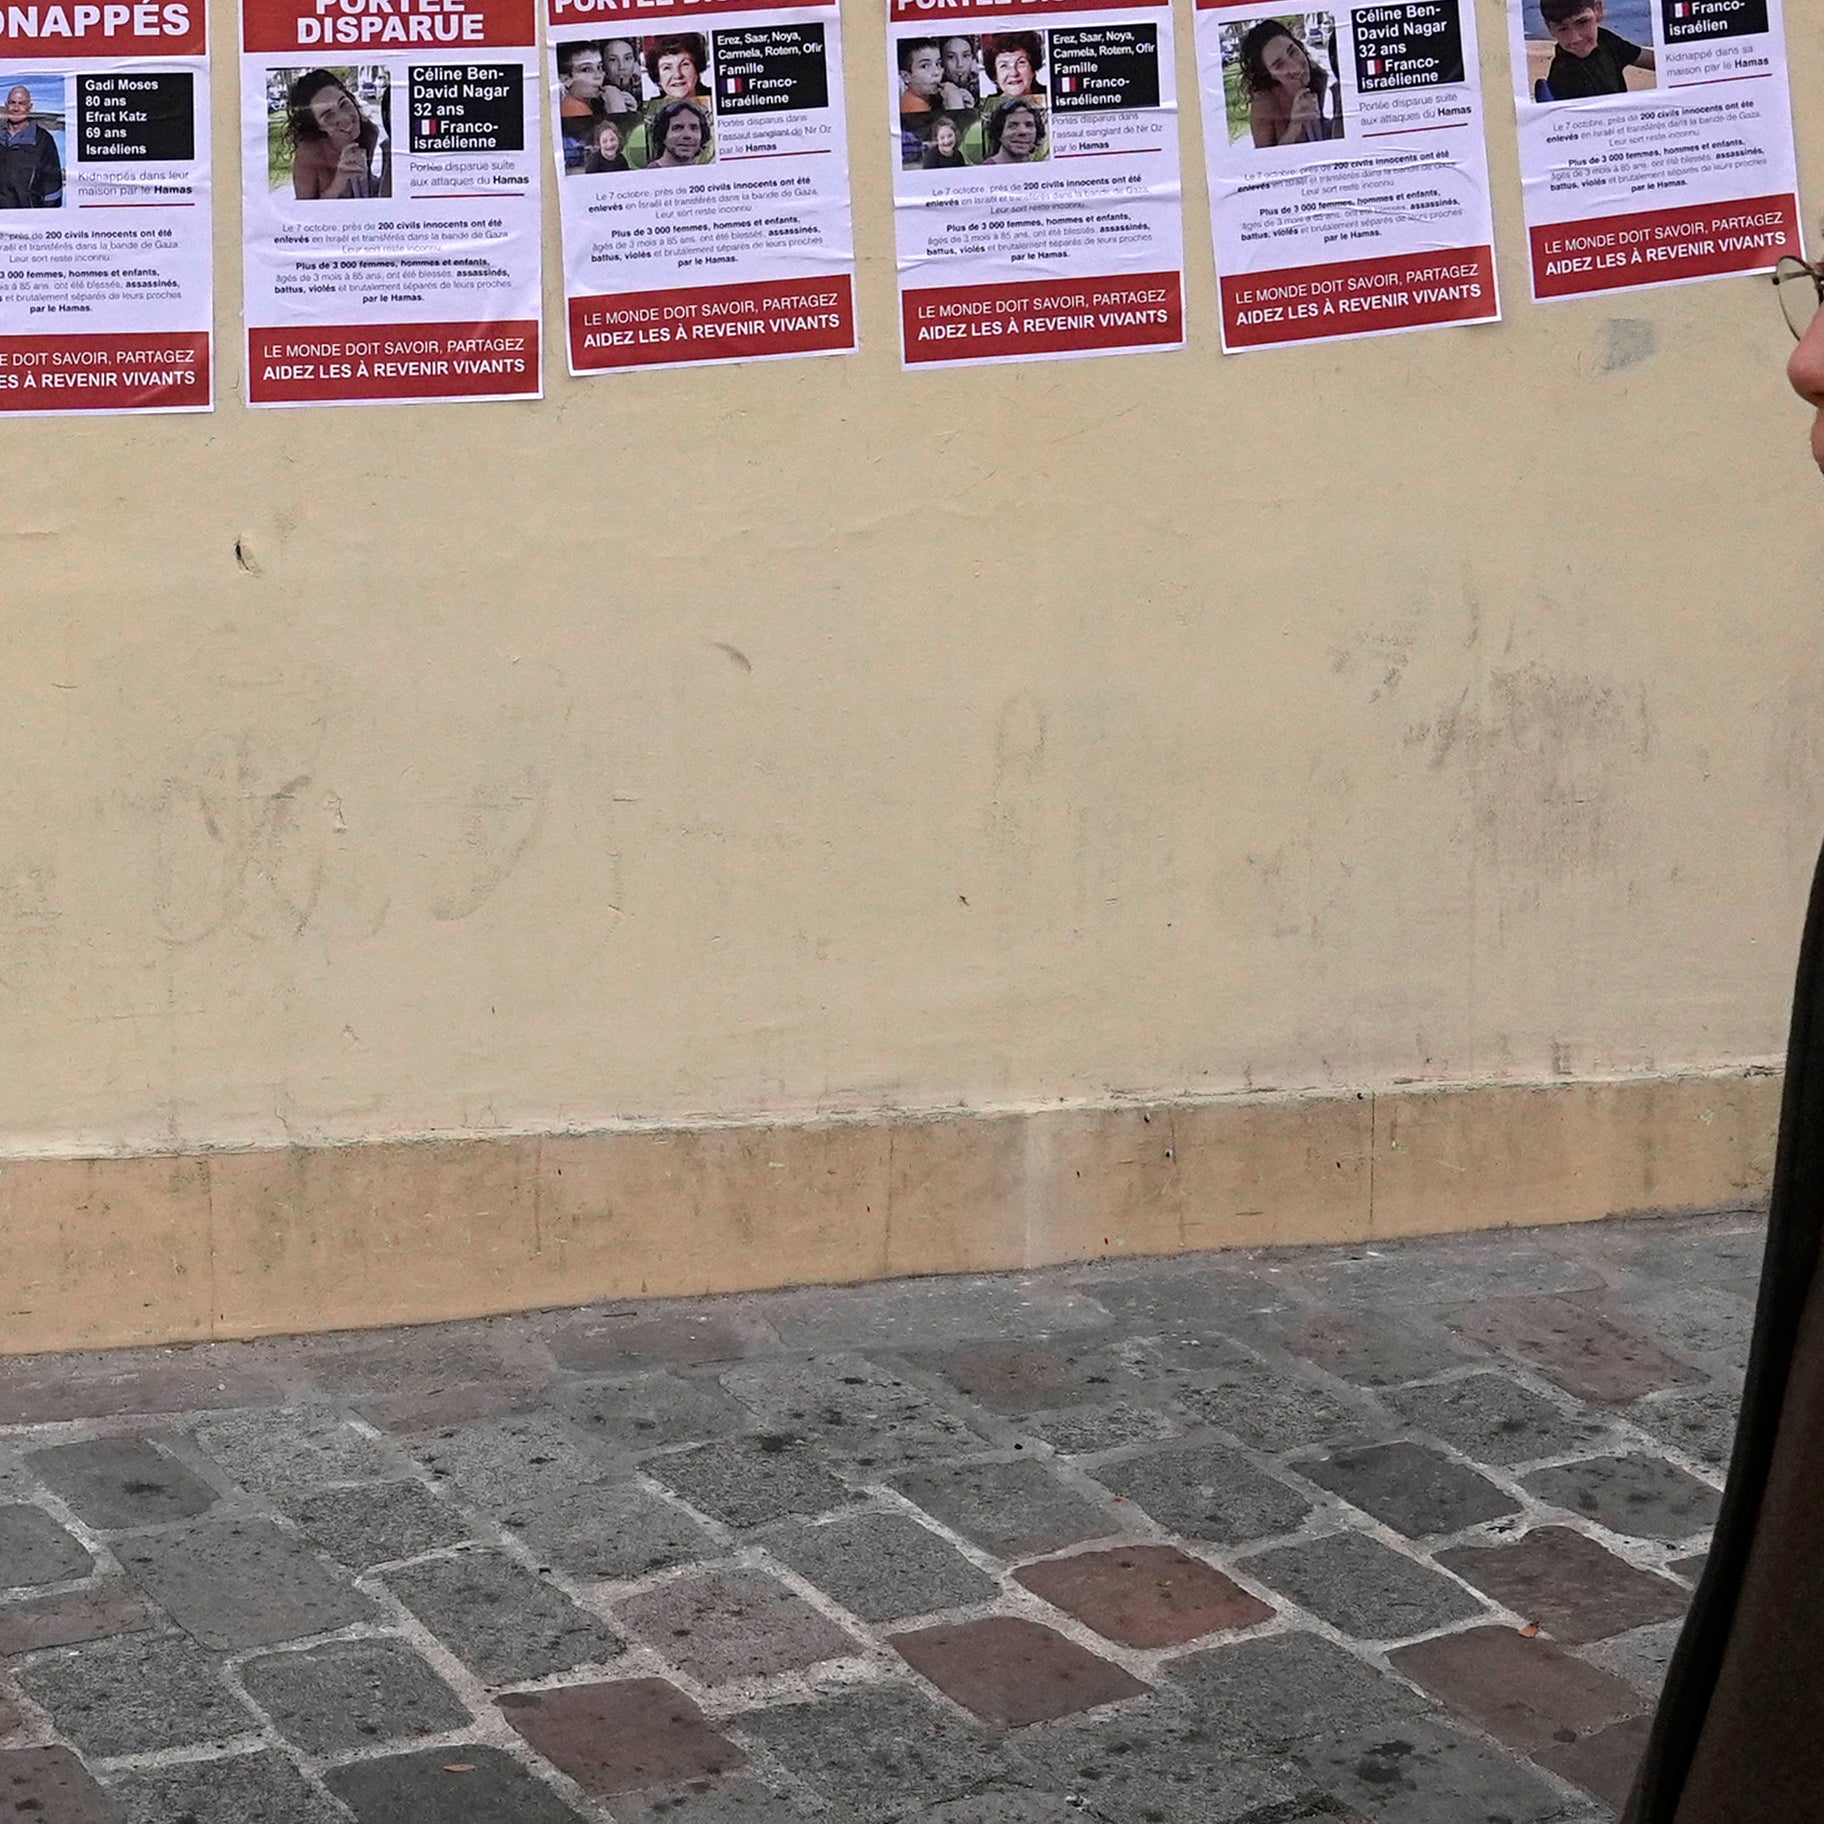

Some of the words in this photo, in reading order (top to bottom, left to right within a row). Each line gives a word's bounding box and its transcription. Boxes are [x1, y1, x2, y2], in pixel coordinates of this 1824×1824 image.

[1692, 1, 1745, 14] Franco-
[298, 14, 484, 43] DISPARUE
[1670, 19, 1727, 36] israélien
[414, 68, 462, 81] Céline
[468, 67, 503, 80] Ben-
[414, 85, 457, 98] David
[463, 84, 509, 100] Nagar
[414, 103, 431, 116] 32
[437, 105, 464, 115] ans
[441, 121, 498, 133] Franco-
[415, 136, 496, 149] israélienne
[13, 353, 48, 366] DOIT
[53, 352, 111, 365] SAVOIR,
[117, 350, 194, 363] PARTAGEZ
[24, 371, 36, 388] À
[42, 373, 117, 387] REVENIR
[122, 371, 195, 385] VIVANTS
